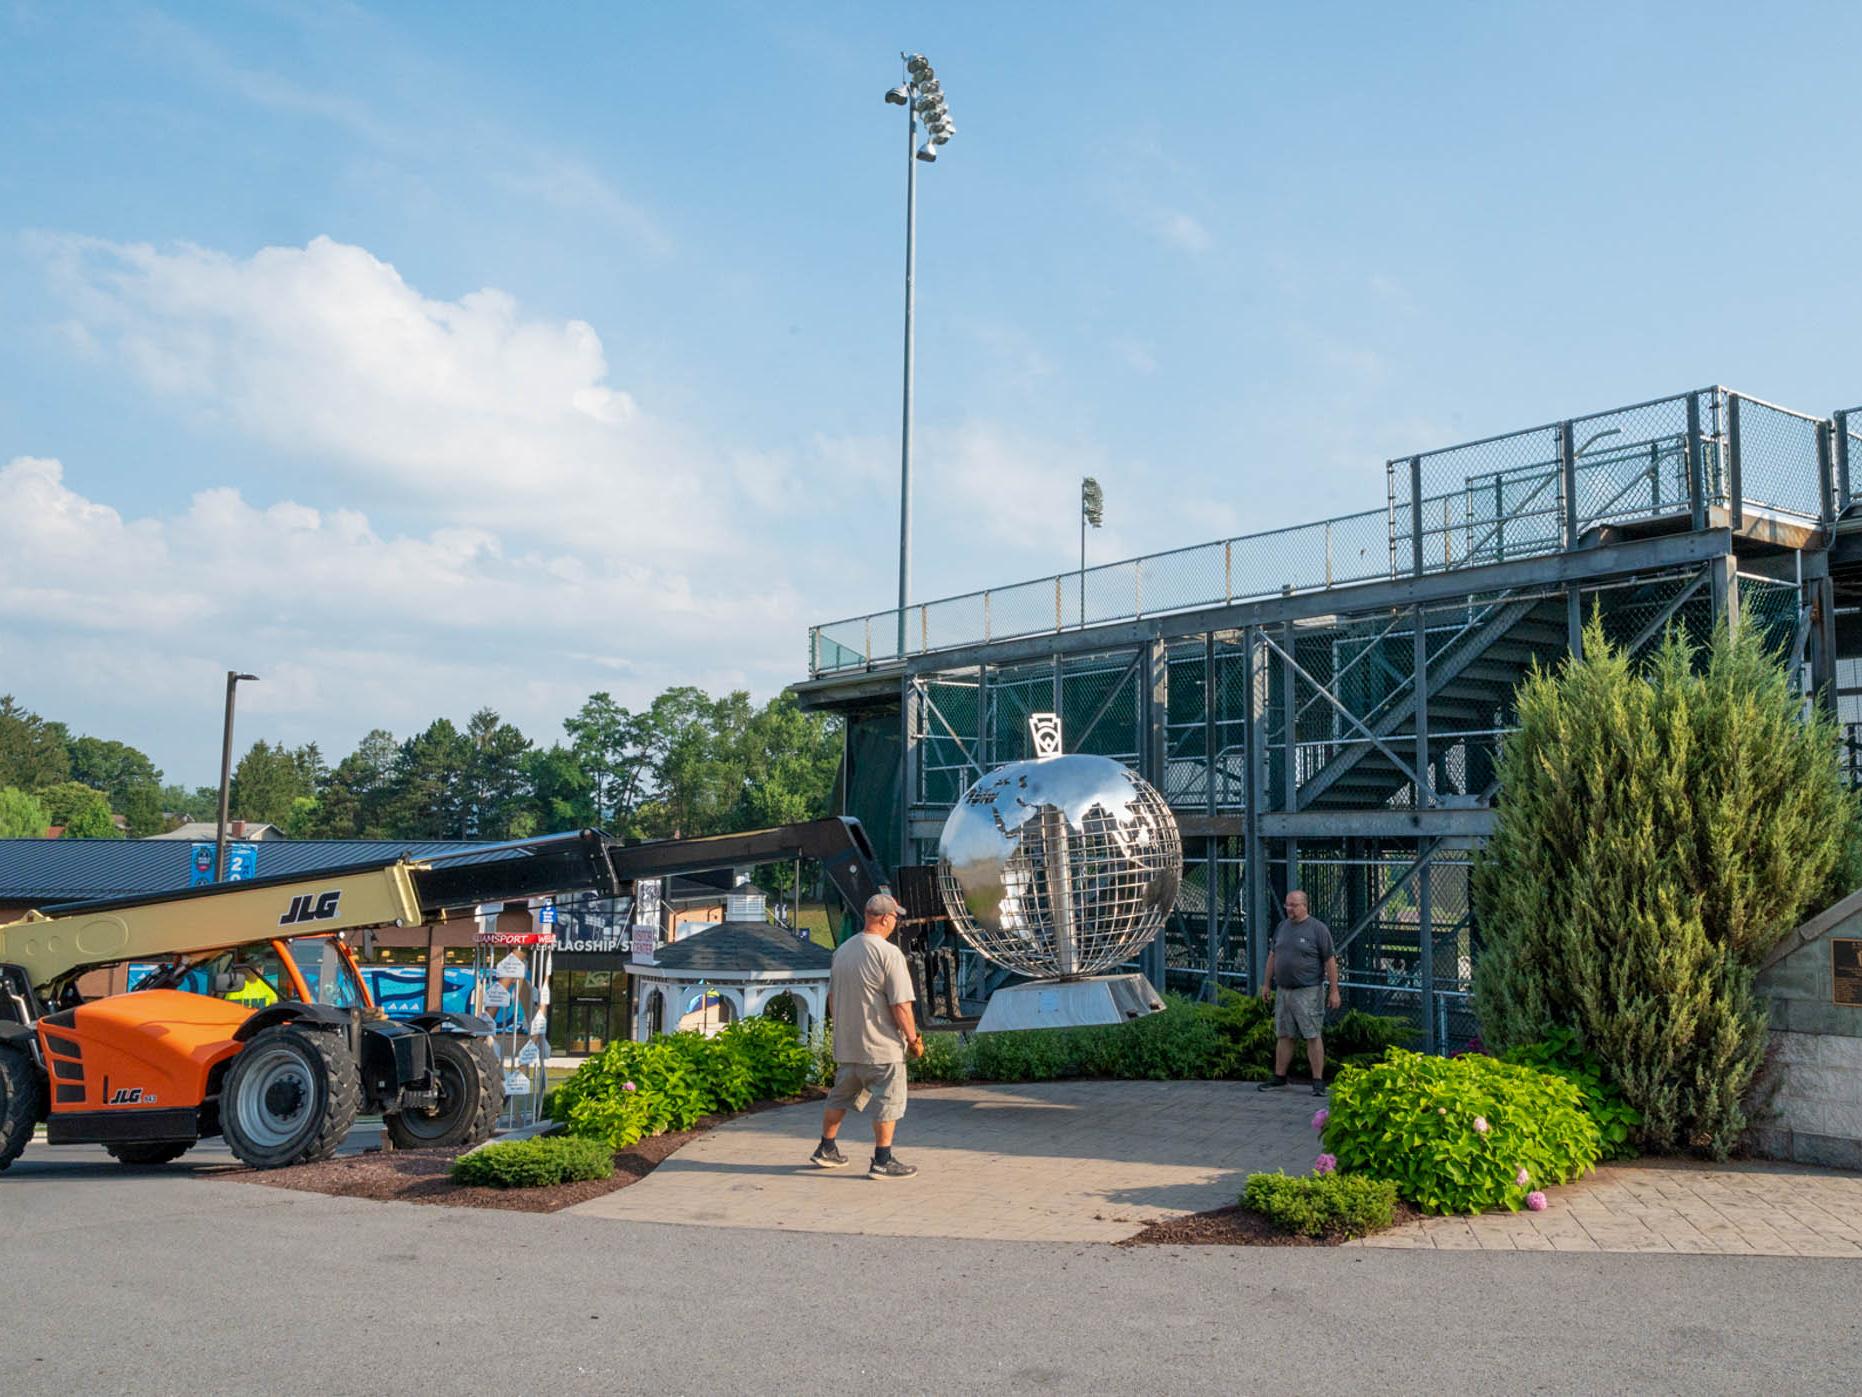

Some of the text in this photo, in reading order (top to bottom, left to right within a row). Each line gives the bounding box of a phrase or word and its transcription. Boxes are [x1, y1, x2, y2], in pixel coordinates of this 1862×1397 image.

[279, 890, 341, 926] JLG
[551, 940, 616, 952] FLAGSHIP
[110, 1088, 143, 1105] JLG
